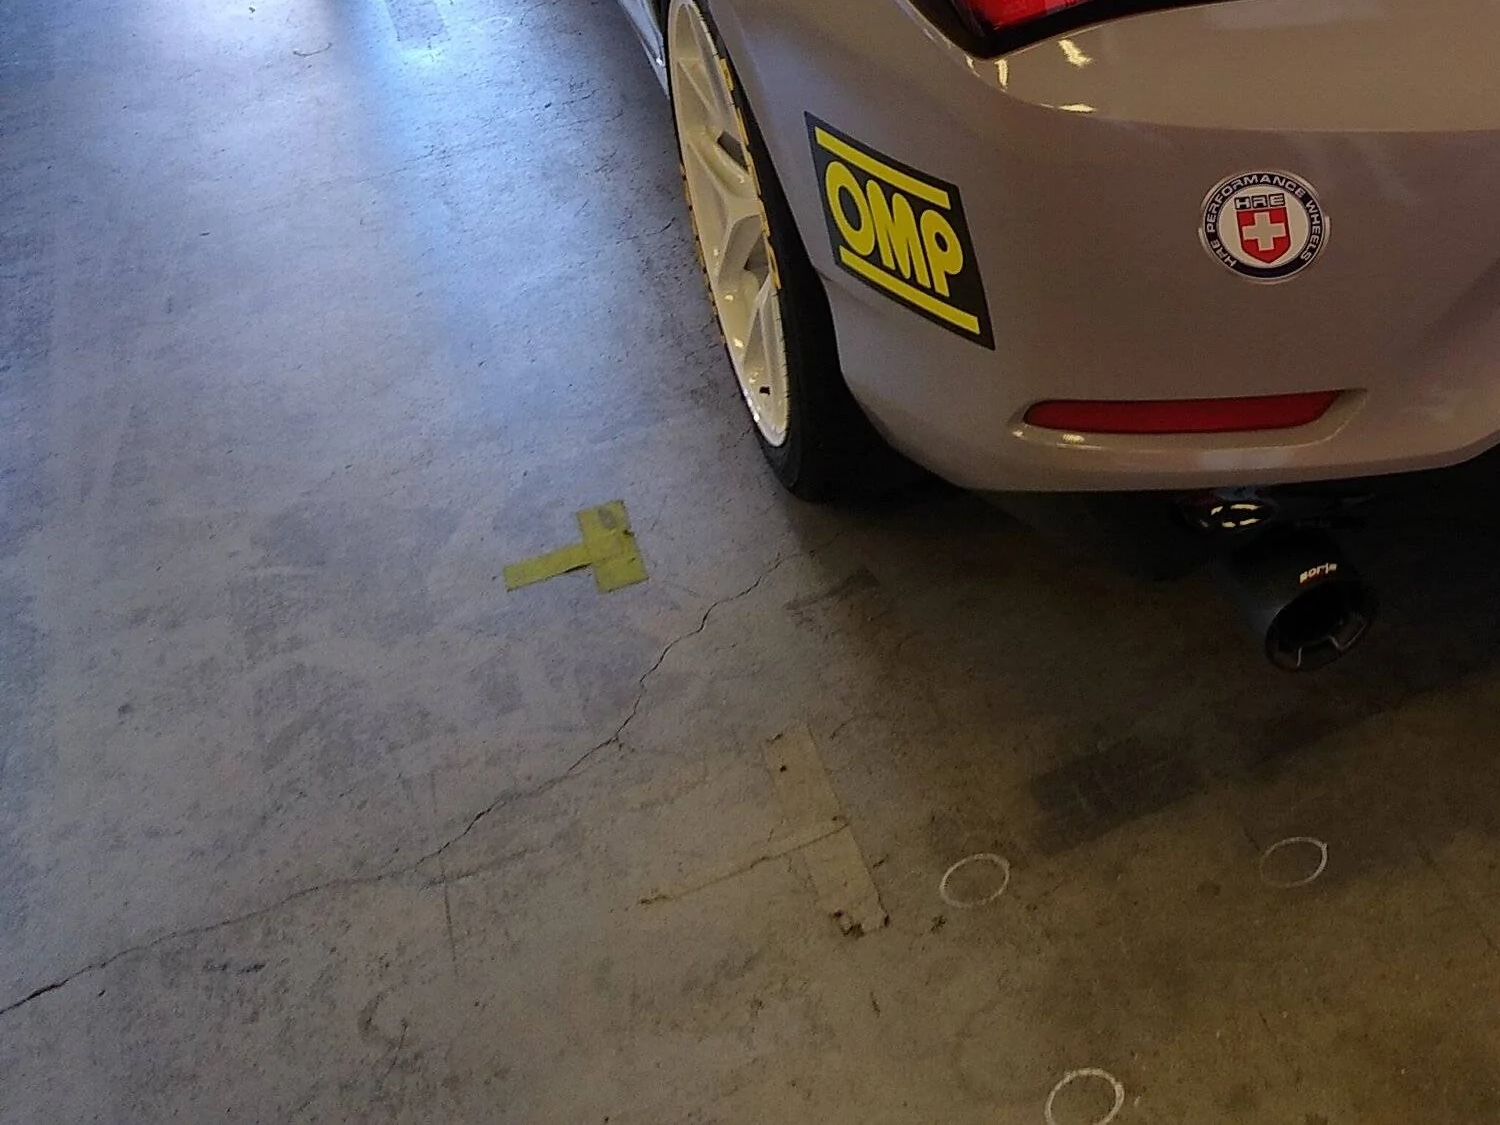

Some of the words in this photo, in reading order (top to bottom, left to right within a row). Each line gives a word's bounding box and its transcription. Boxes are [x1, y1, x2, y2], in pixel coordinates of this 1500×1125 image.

[825, 161, 964, 297] OMP
[1206, 175, 1306, 233] PERFORMANCE
[1300, 200, 1321, 262] WHEELS
[1235, 193, 1285, 209] HRE
